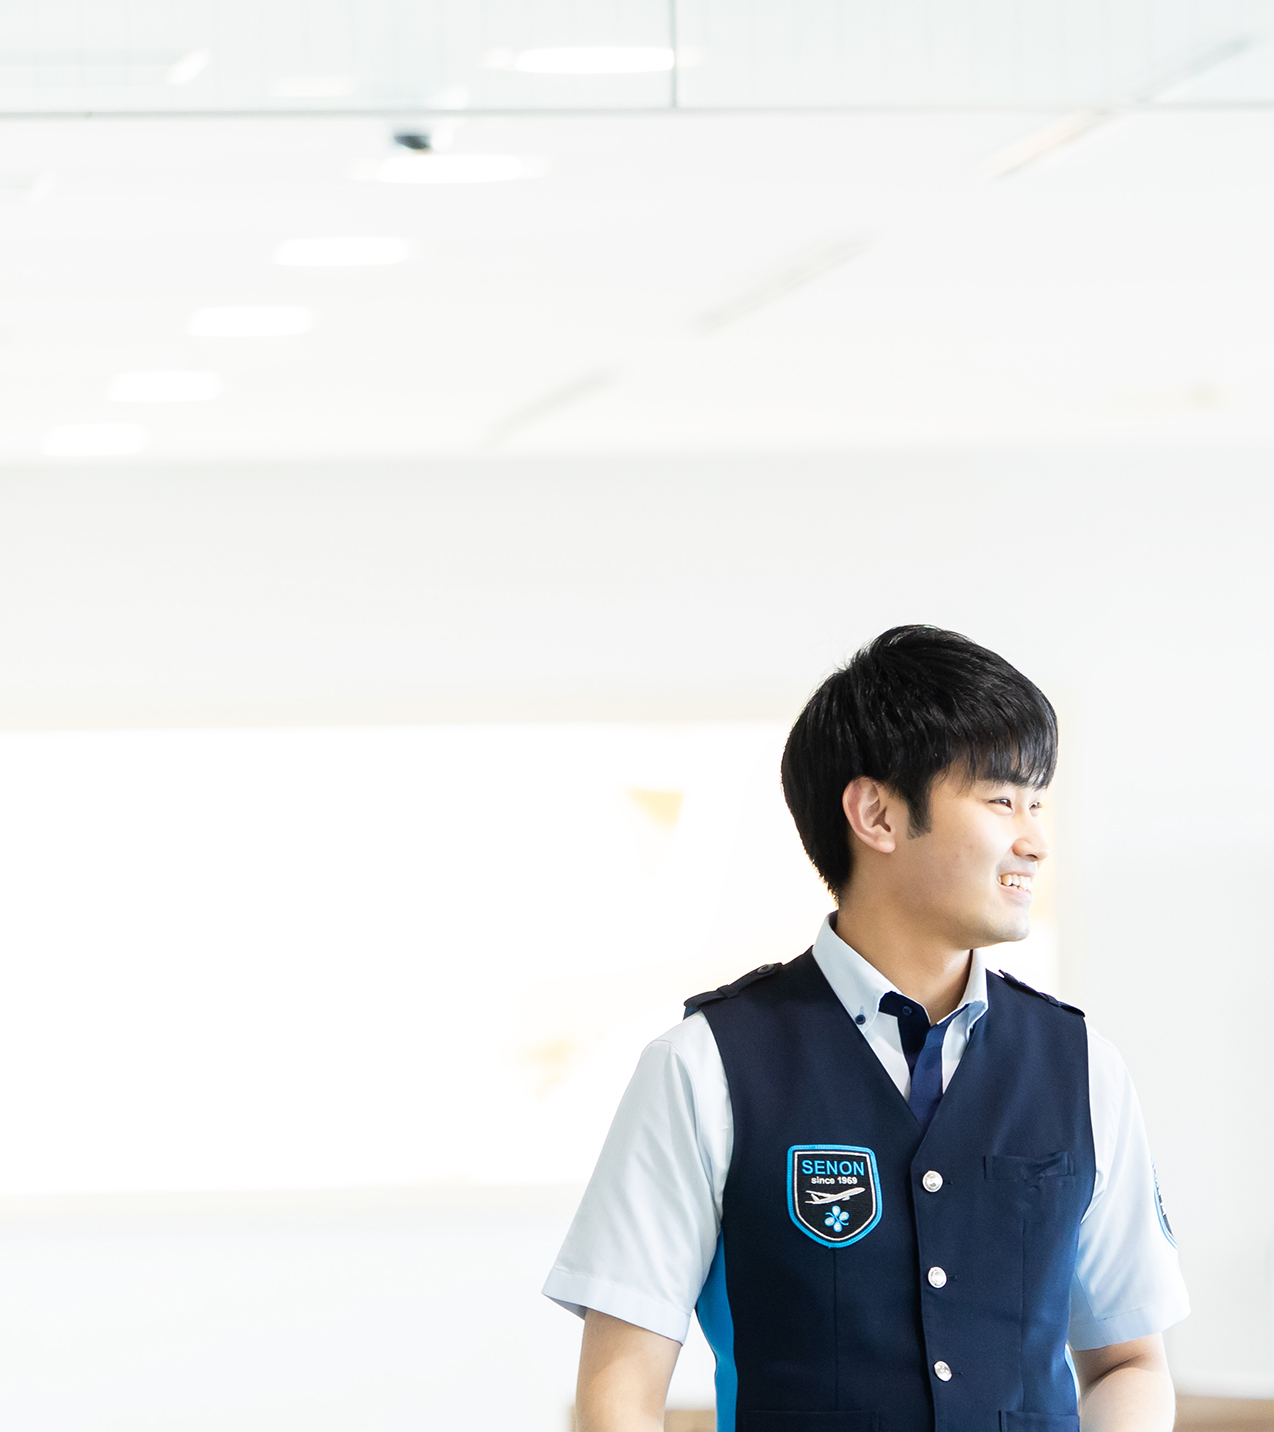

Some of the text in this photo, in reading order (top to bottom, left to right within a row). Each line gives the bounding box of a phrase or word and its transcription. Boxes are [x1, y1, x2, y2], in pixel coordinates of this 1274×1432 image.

[802, 1160, 864, 1175] SENON
[811, 1176, 857, 1185] since 1969
